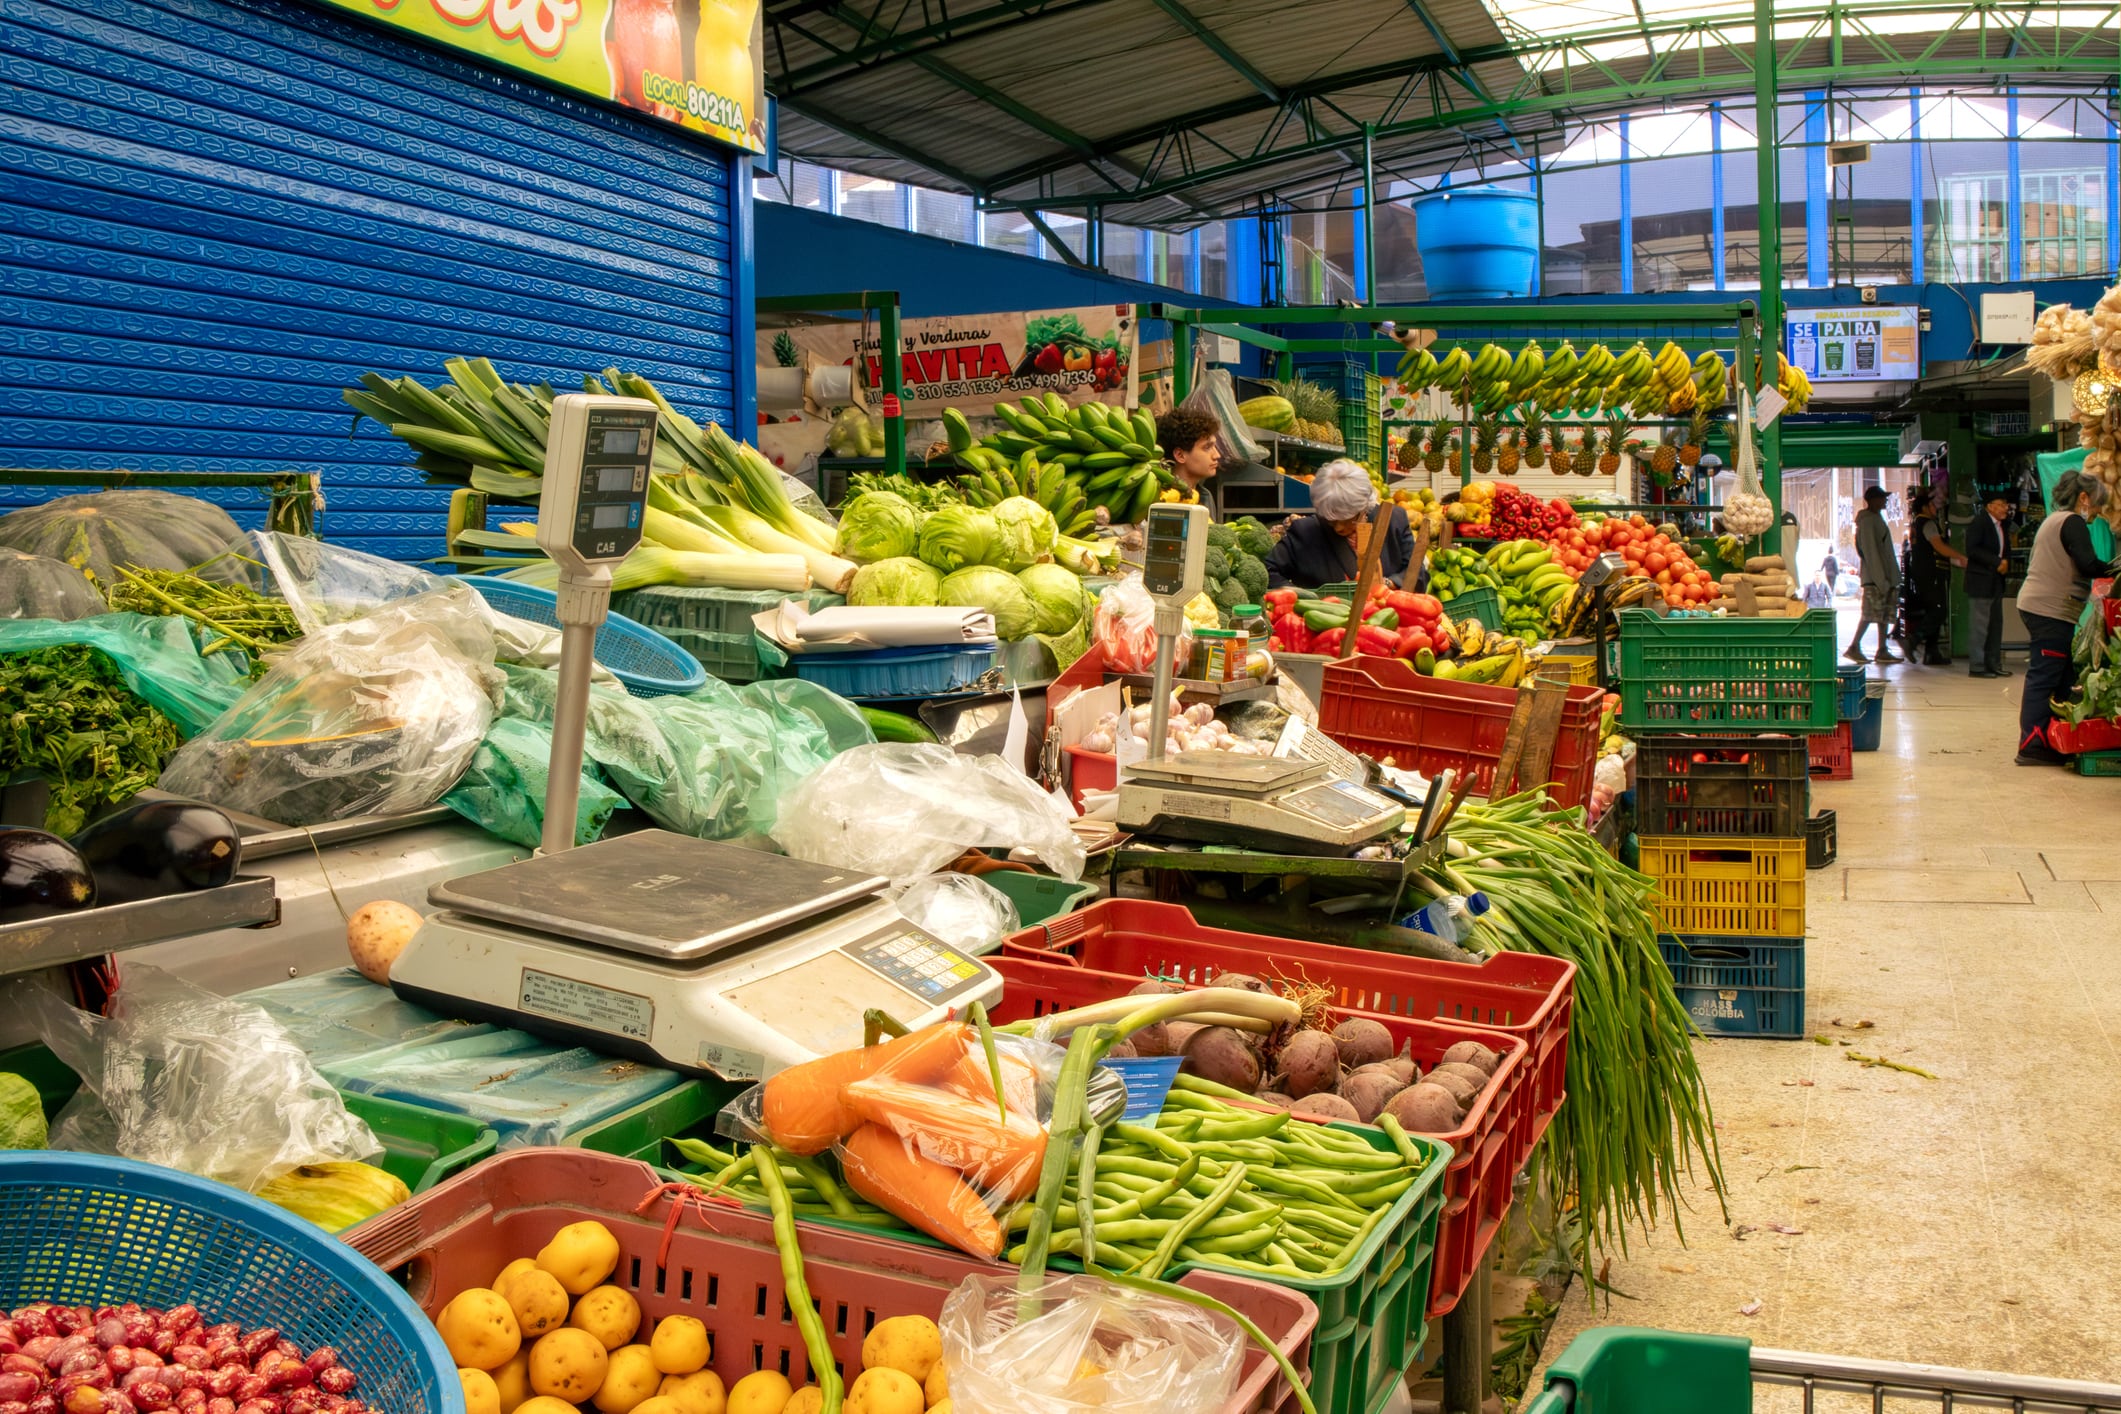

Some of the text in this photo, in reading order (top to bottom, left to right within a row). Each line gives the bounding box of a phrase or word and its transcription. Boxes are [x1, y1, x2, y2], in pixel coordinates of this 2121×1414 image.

[643, 73, 746, 132] LOCAL 80211A
[1794, 322, 1876, 336] SE PA RA
[904, 336, 917, 350] y
[920, 328, 991, 345] Verduras
[843, 343, 1013, 389] HAVITA
[917, 386, 941, 400] 310
[944, 383, 969, 397] 554
[1034, 373, 1060, 388] 499
[1062, 370, 1097, 386] 7336
[596, 542, 616, 554] CAS
[1691, 1007, 1744, 1018] COLOMBIA
[1703, 1000, 1732, 1009] HASS
